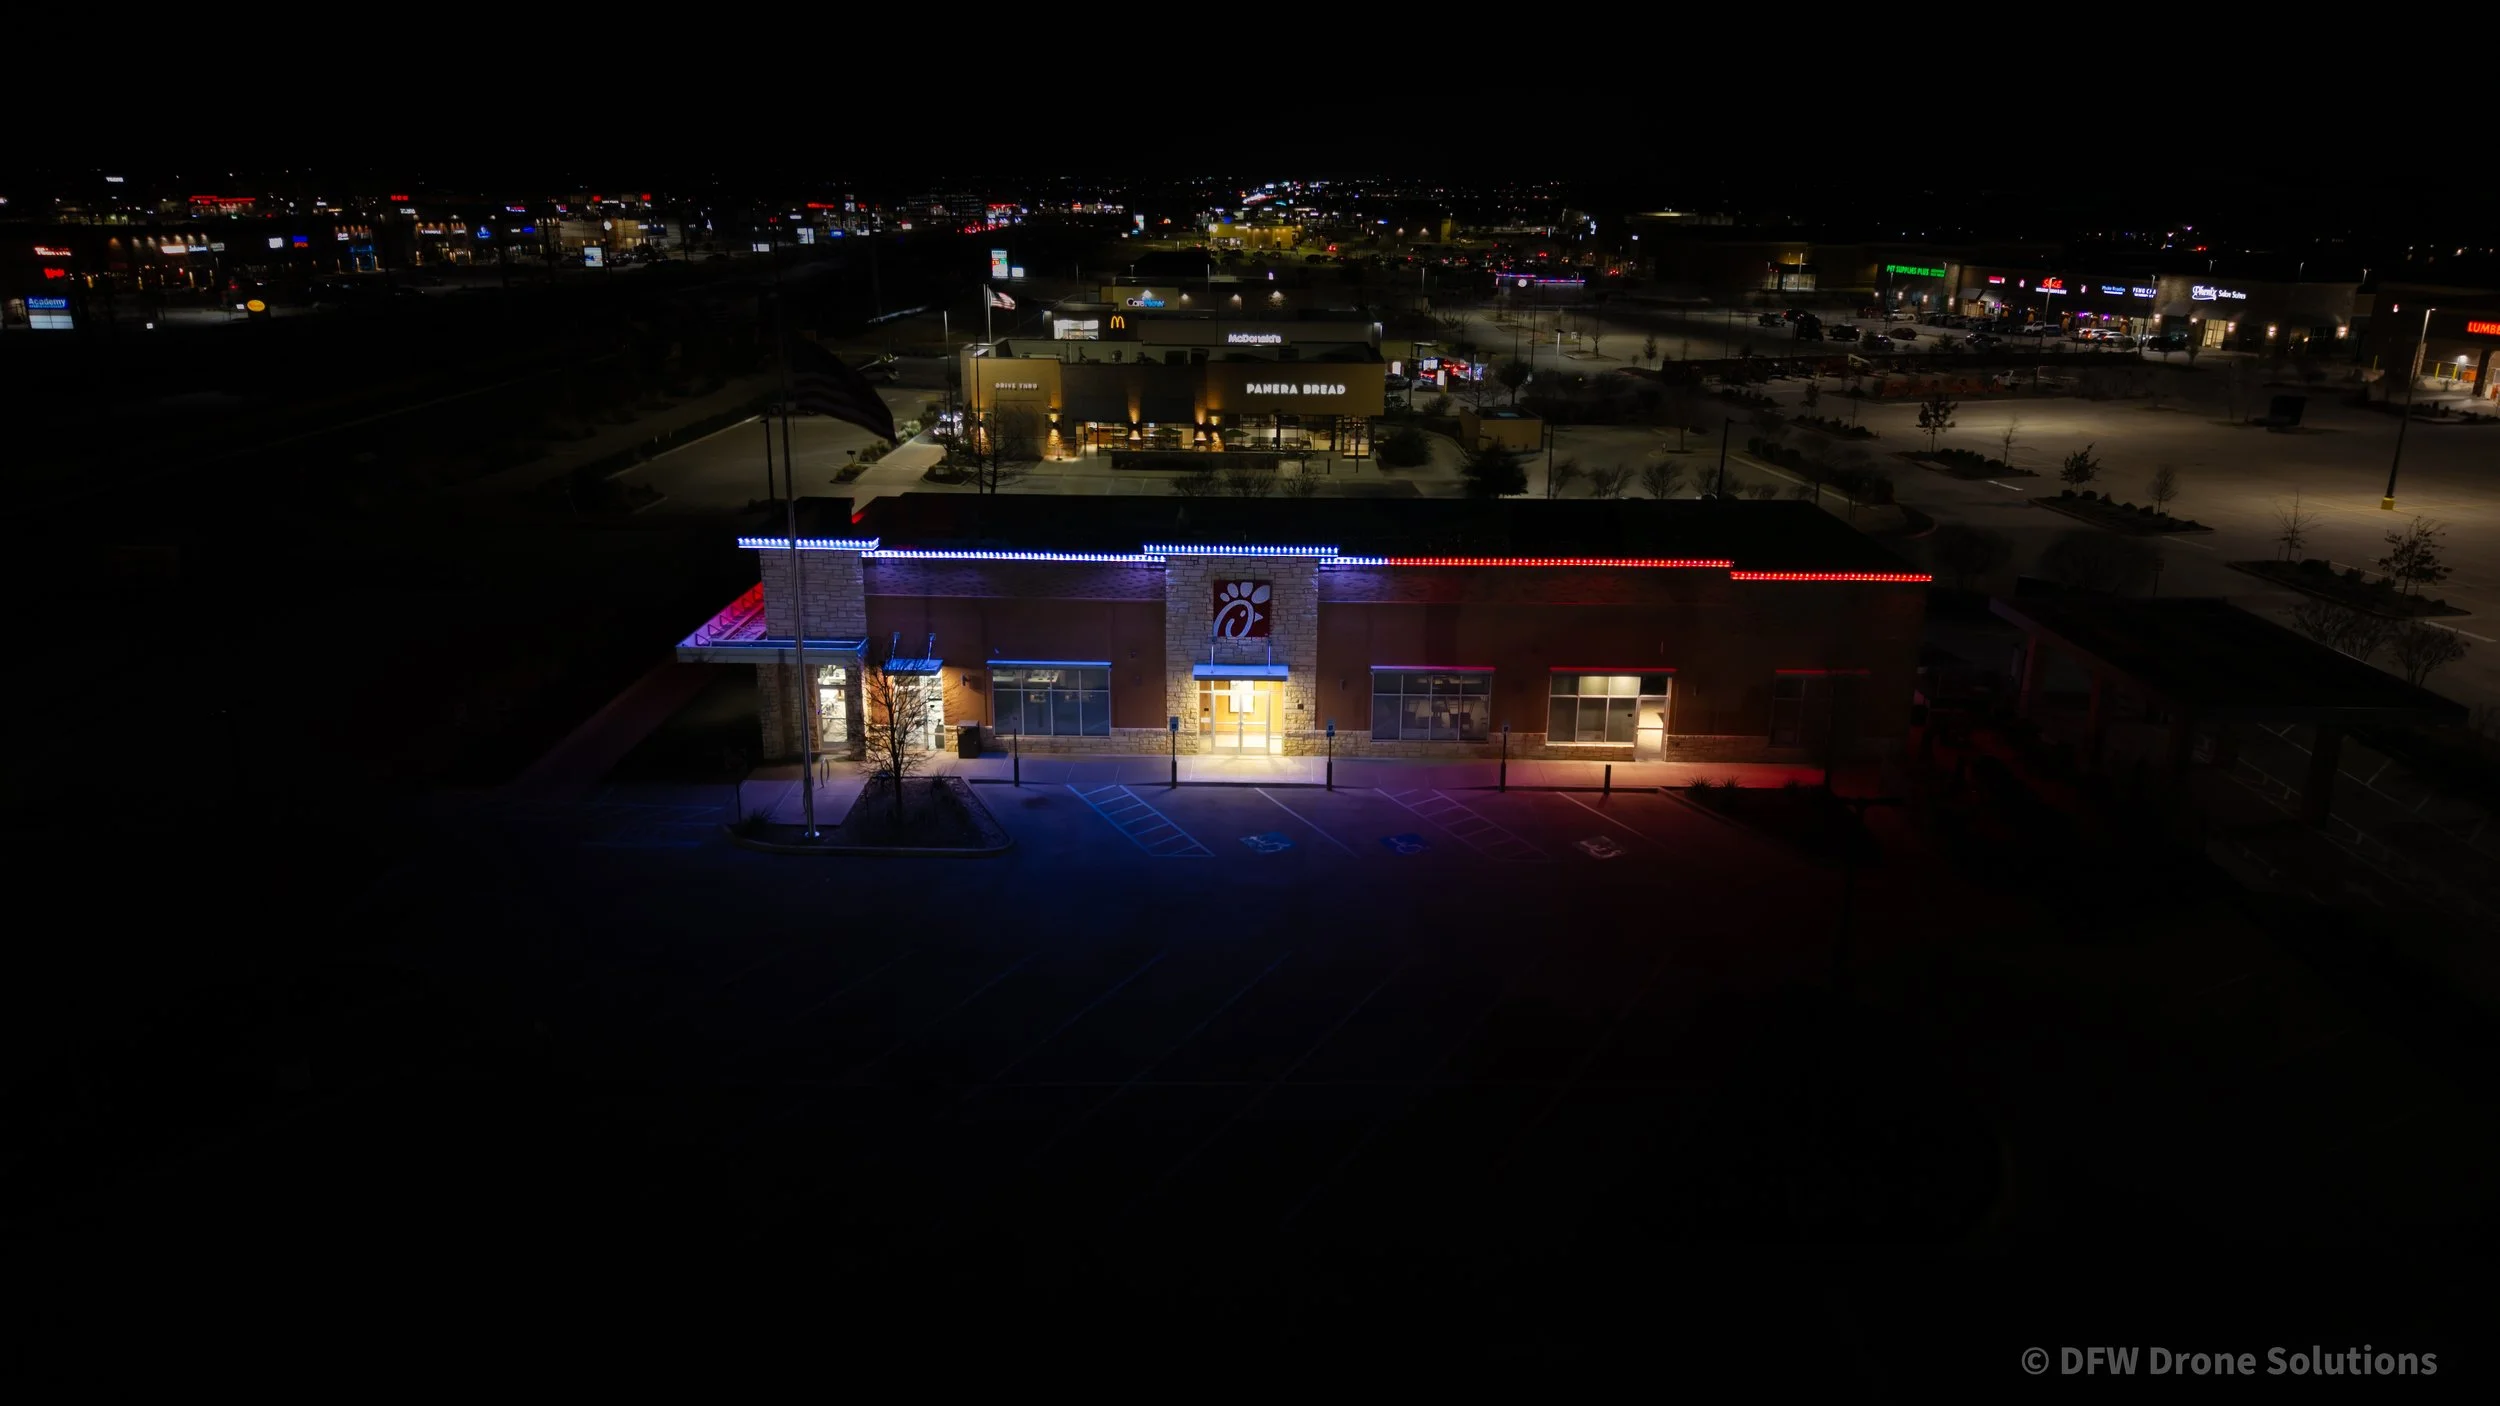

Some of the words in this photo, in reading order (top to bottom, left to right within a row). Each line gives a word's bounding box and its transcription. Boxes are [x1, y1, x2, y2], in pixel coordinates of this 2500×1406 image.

[1917, 267, 1929, 276] PLUS
[29, 298, 65, 306] Academy
[1126, 297, 1165, 308] CareNow
[1228, 334, 1281, 343] McDonald's
[1246, 383, 1298, 394] PANERA
[1303, 384, 1346, 395] BREAD
